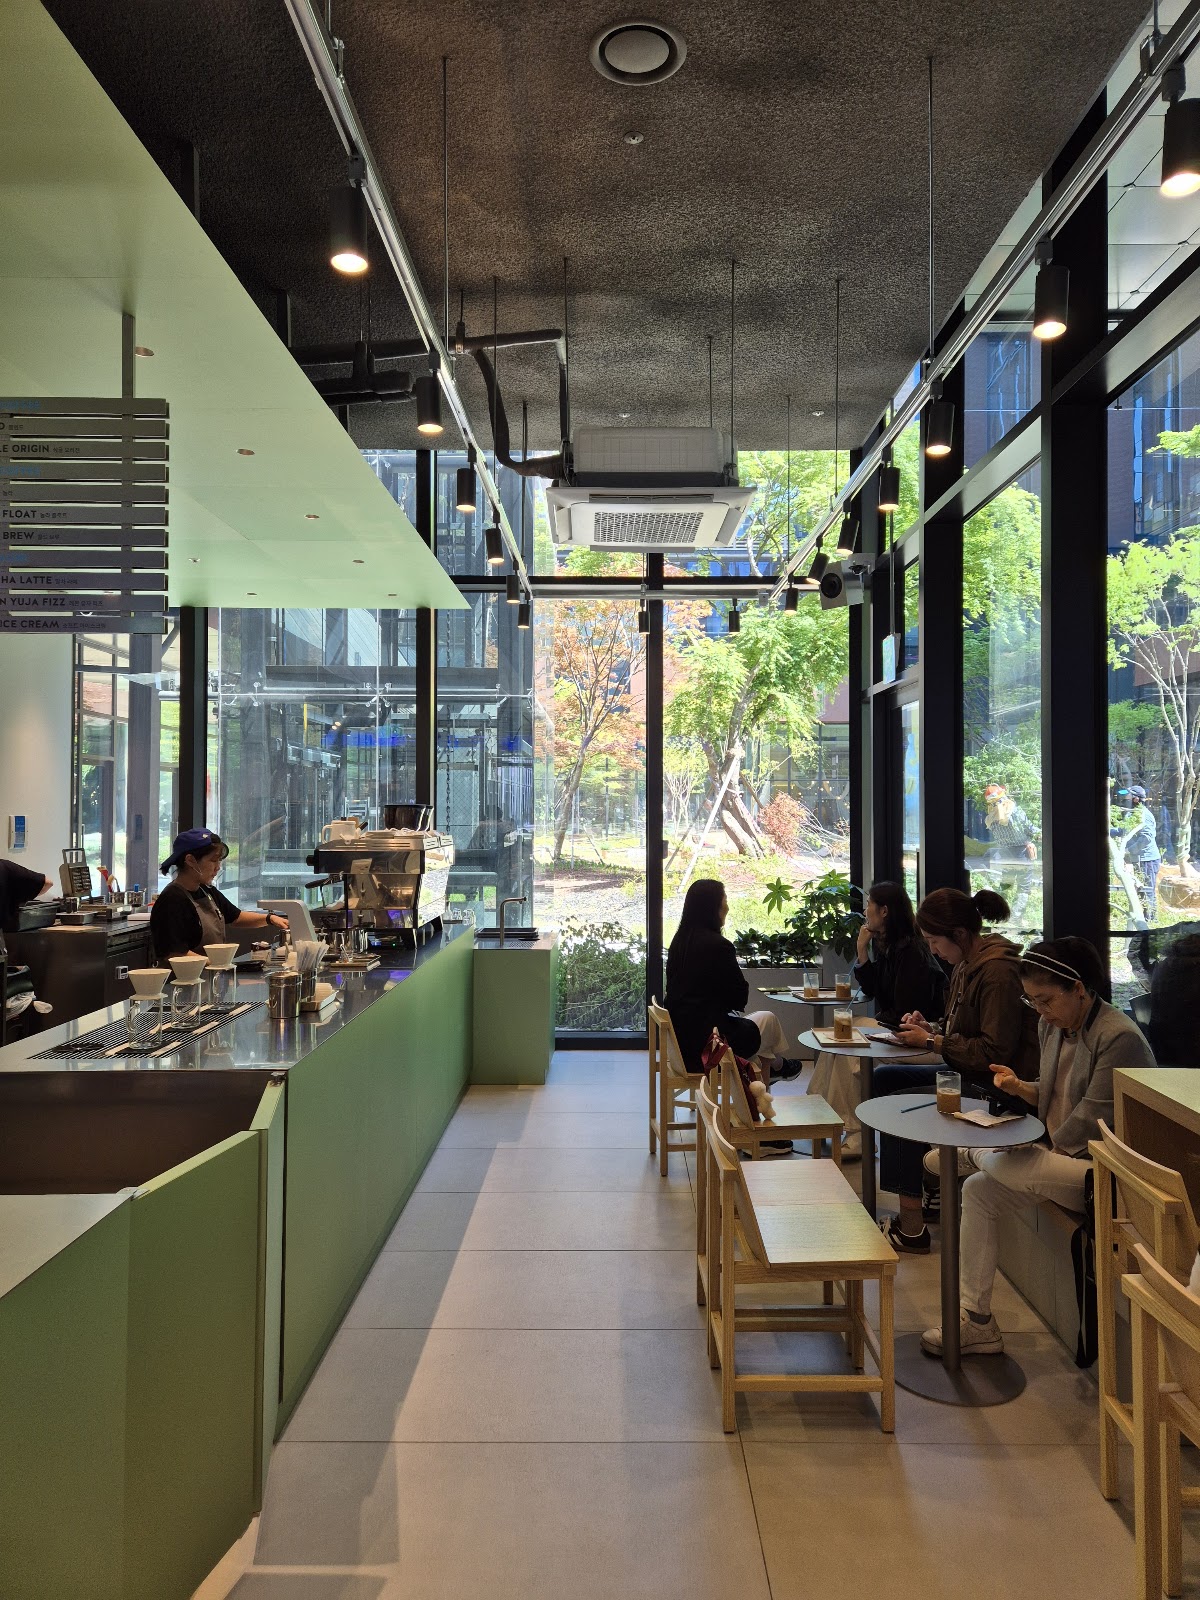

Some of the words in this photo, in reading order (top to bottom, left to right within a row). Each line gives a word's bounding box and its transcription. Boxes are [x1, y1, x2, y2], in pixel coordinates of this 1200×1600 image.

[0, 445, 8, 453] E
[12, 444, 50, 453] ORIGIN
[2, 510, 37, 519] FLOAT
[3, 531, 35, 540] BREW
[1, 576, 16, 584] HA
[20, 576, 52, 584] LATTE
[10, 597, 39, 606] YUJA
[42, 597, 66, 606] FIZZ
[20, 620, 60, 628] CREAM
